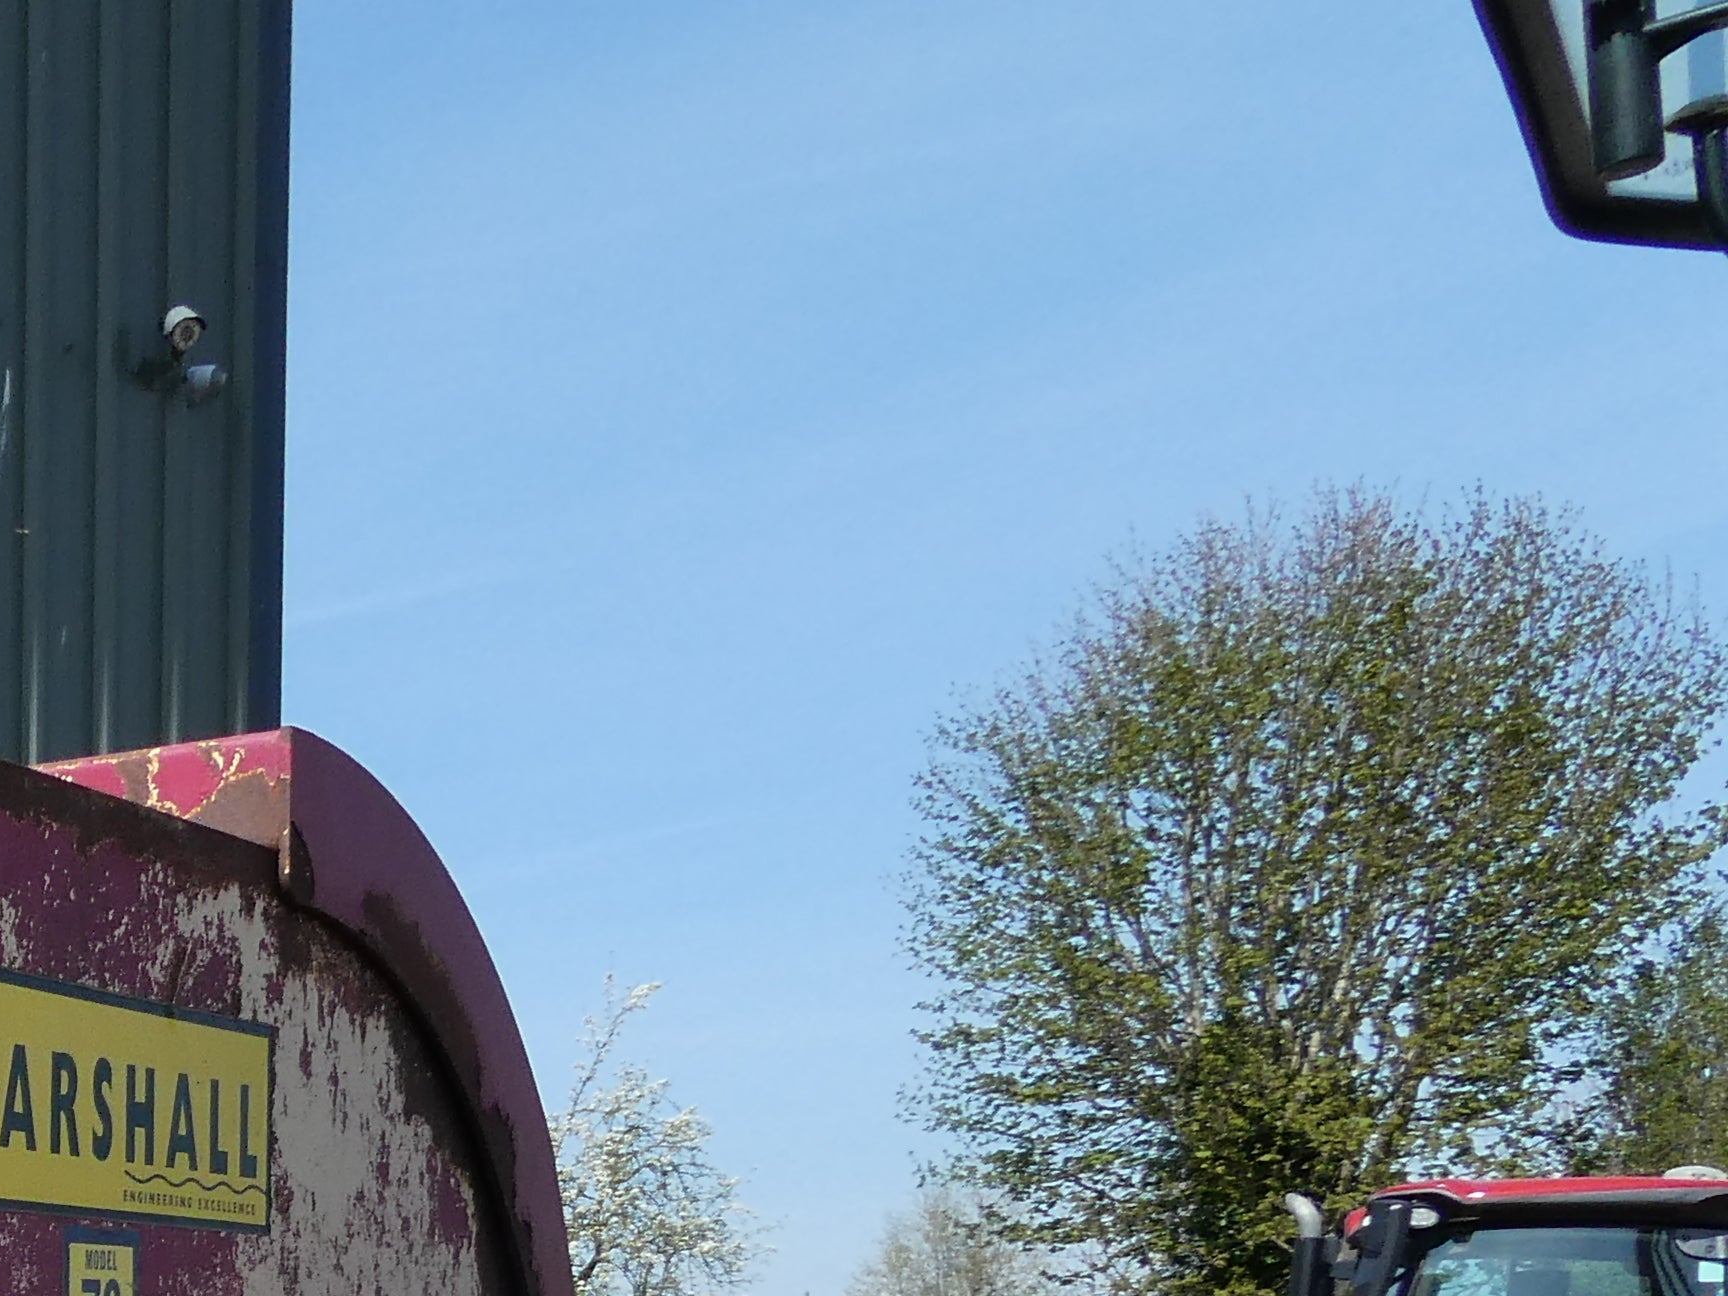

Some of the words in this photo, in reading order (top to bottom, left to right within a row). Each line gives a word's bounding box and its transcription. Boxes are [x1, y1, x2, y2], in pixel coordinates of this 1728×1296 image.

[123, 1189, 193, 1209] ENGINEERING
[197, 1198, 257, 1216] EXCELLENCE
[84, 1249, 118, 1271] MODEL
